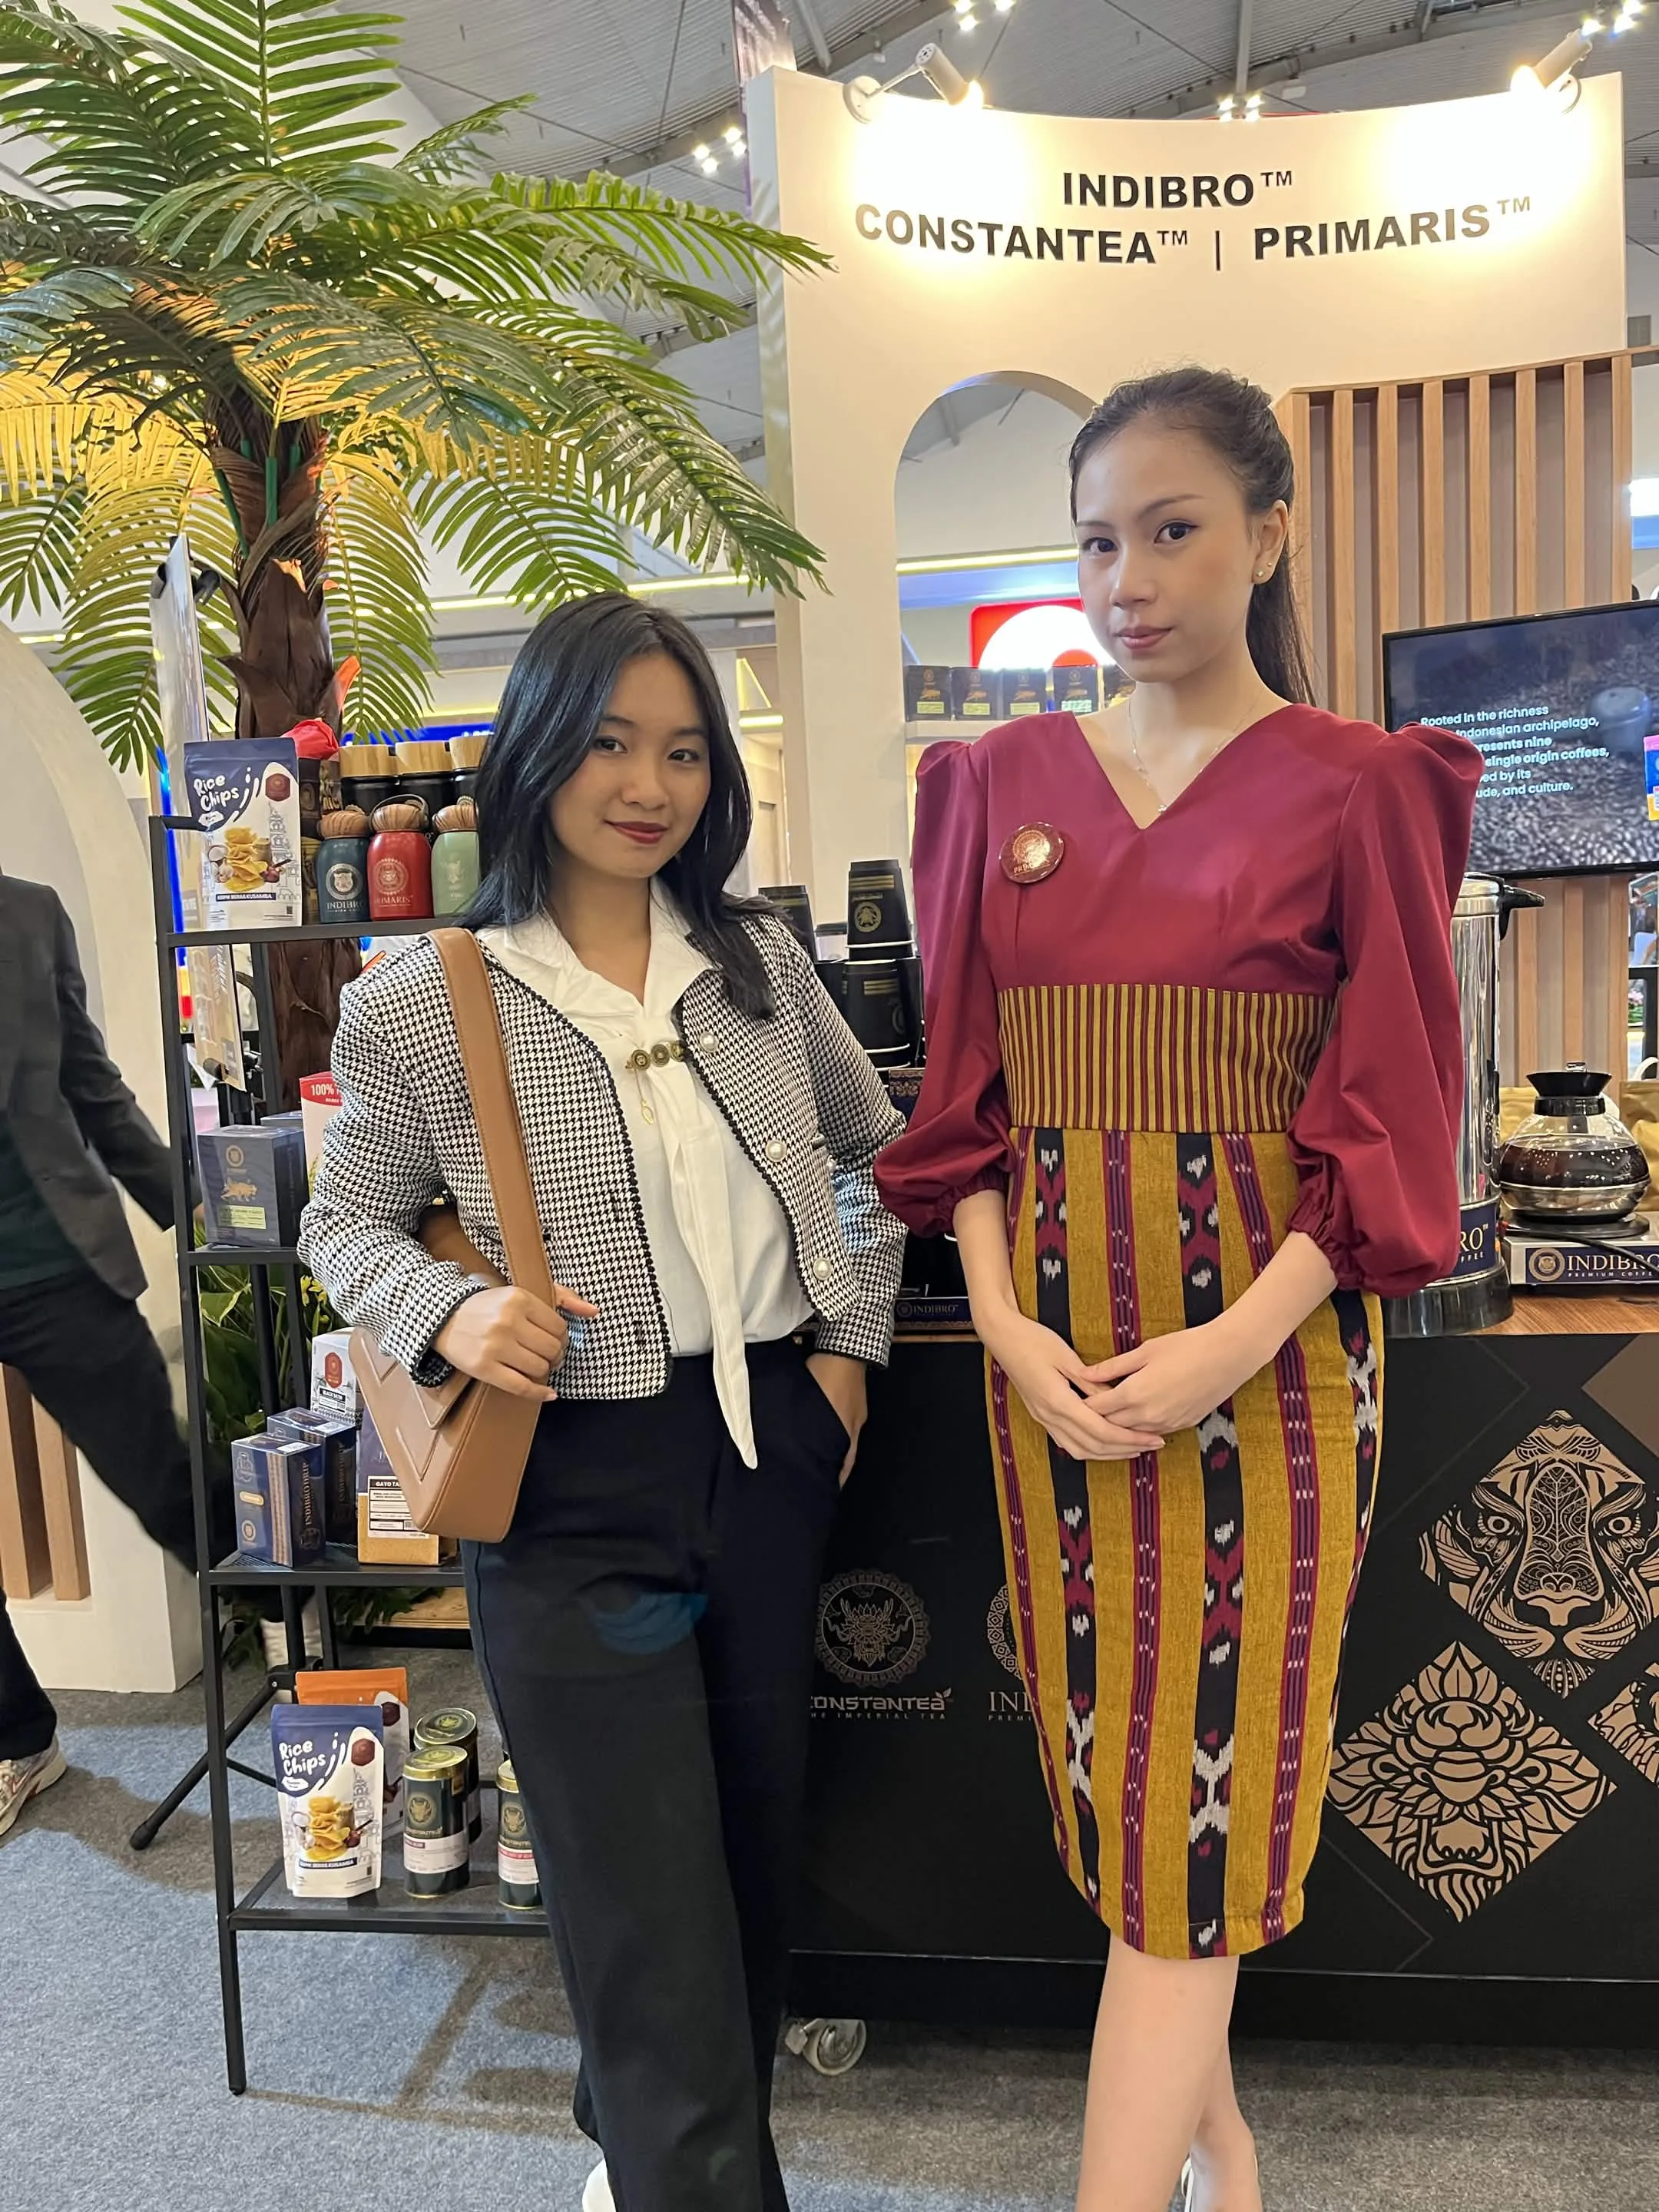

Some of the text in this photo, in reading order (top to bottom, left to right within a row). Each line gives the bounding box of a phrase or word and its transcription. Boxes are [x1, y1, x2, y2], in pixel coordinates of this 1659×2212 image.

[1420, 706, 1549, 727] Rooted in the richness
[1523, 717, 1600, 733] archipelago,
[1479, 736, 1552, 752] resents nine
[1485, 747, 1609, 767] single origin coffees,
[194, 775, 226, 797] Rice
[1499, 770, 1515, 783] by
[1517, 769, 1532, 780] its
[200, 786, 240, 811] Chips
[1502, 784, 1526, 796] and
[1528, 782, 1574, 794] culture.
[311, 1083, 334, 1096] 100%
[279, 1740, 313, 1760] Rice
[283, 1753, 326, 1776] Chips
